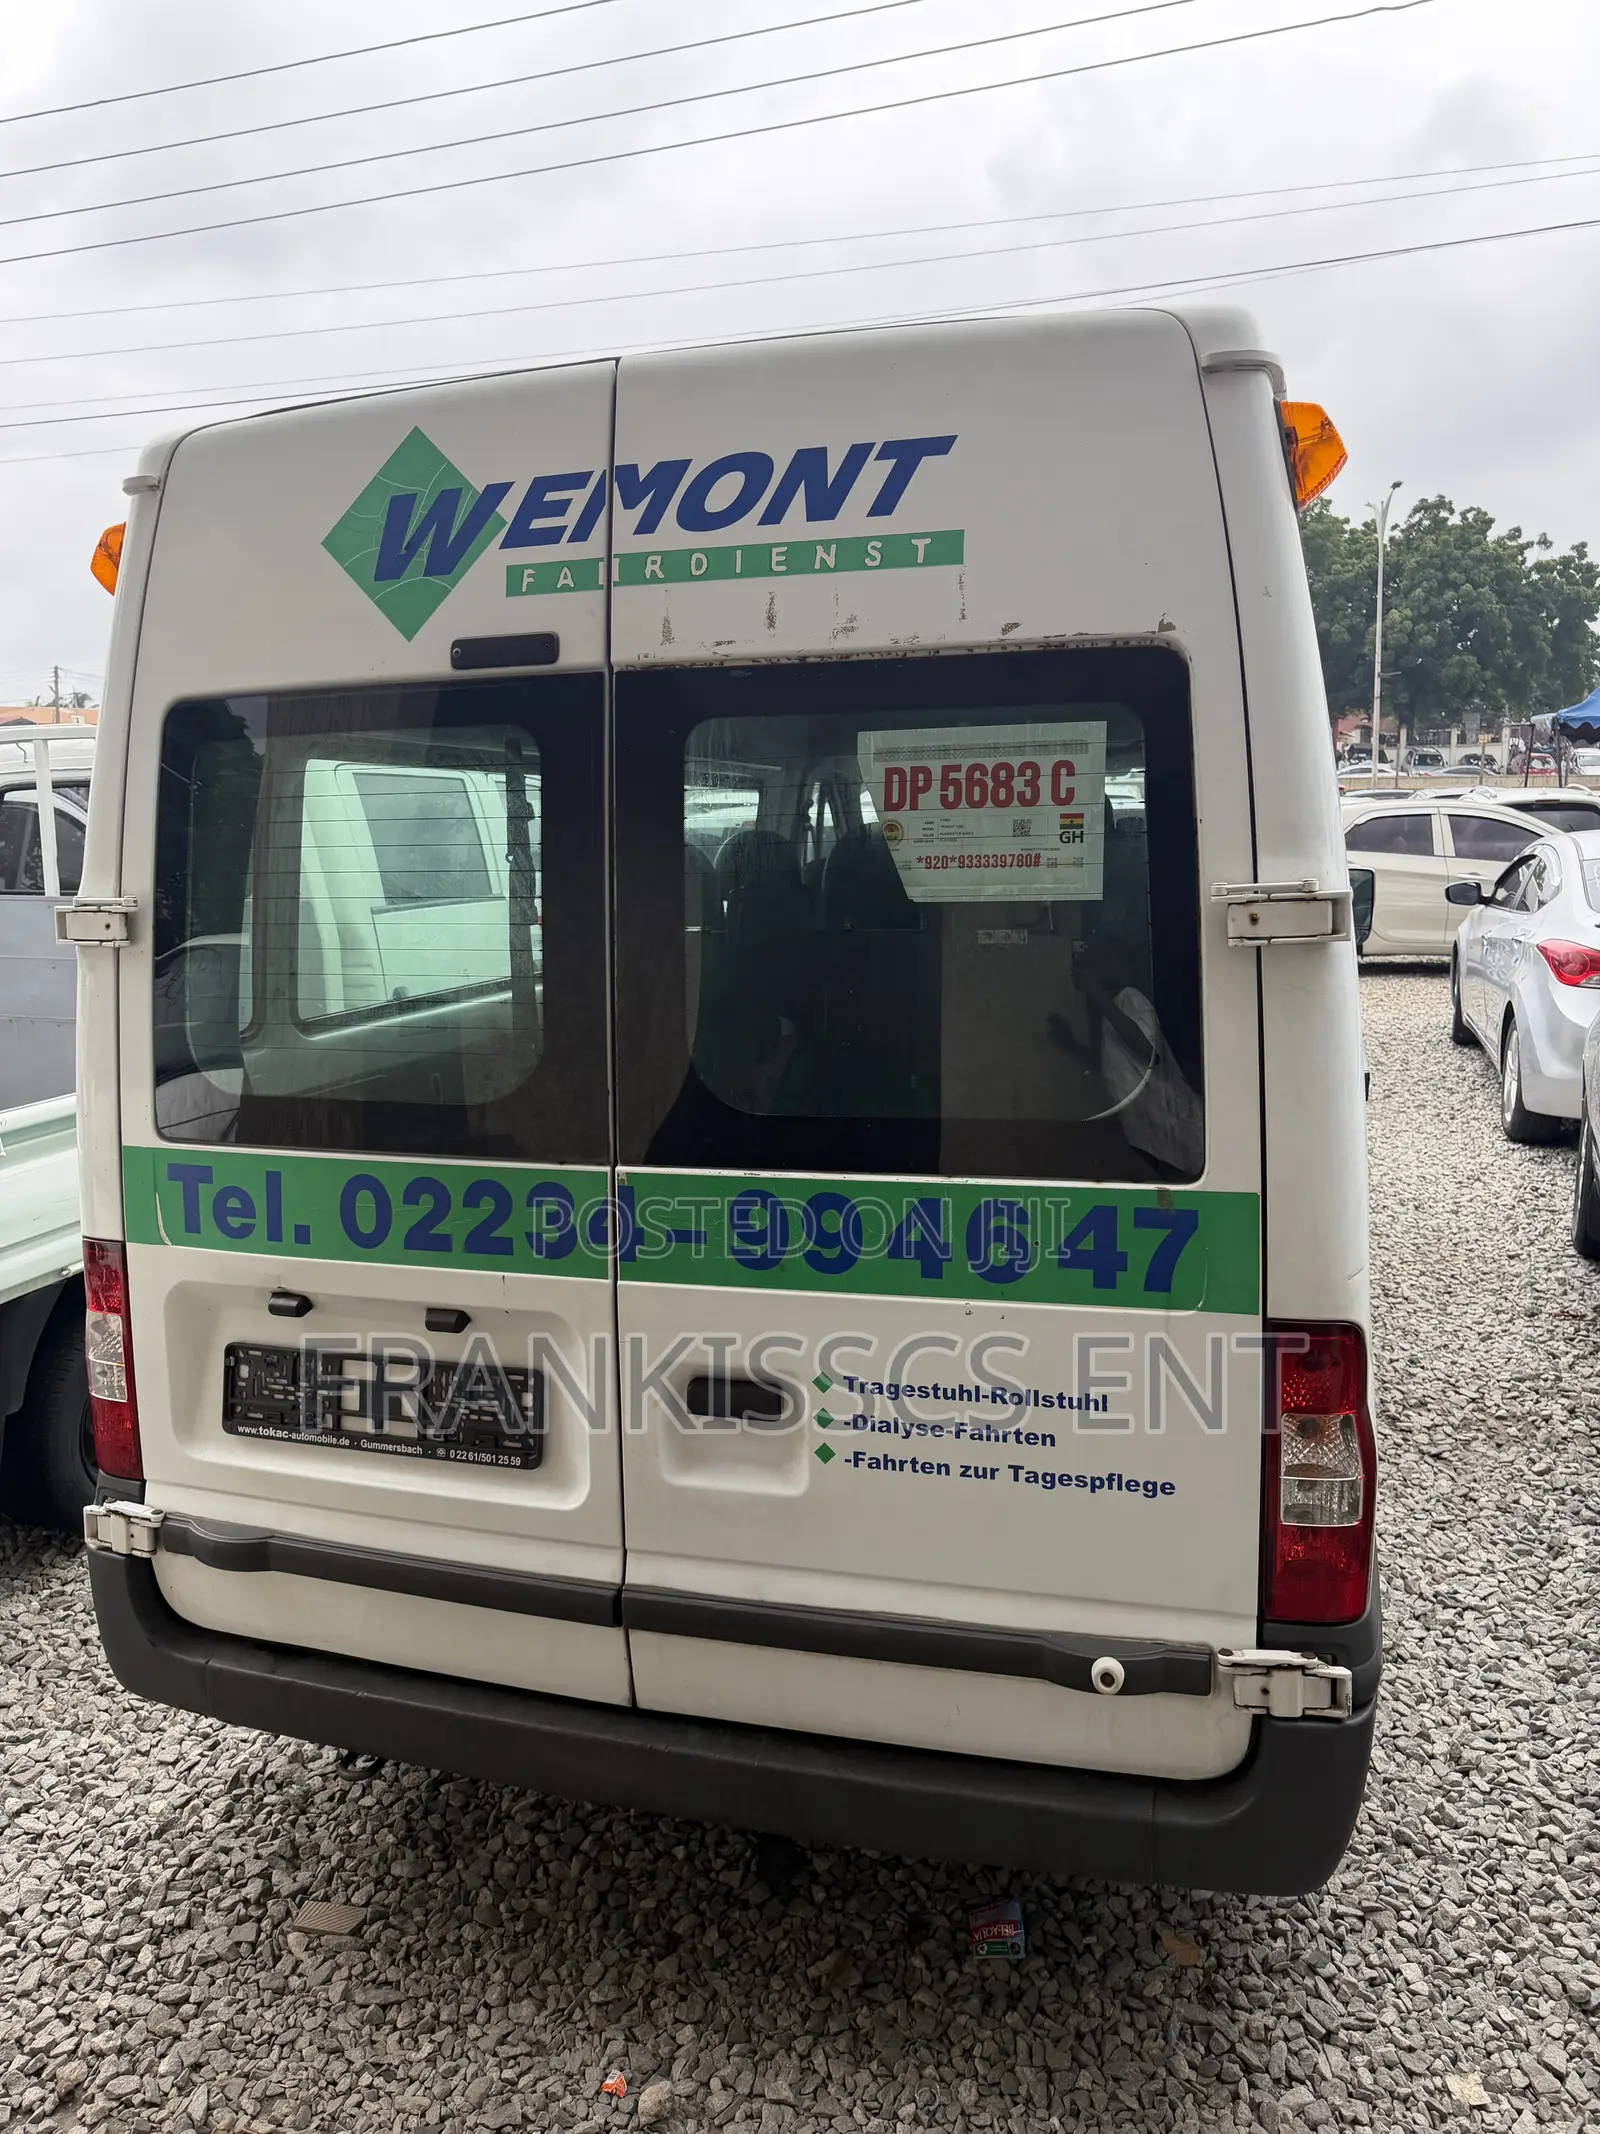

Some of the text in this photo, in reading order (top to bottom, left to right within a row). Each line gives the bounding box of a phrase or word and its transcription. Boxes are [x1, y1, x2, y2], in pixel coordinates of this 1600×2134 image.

[374, 435, 958, 581] WEMONT
[884, 760, 1075, 811] DP 5683 C
[1059, 831, 1084, 844] GH
[167, 1163, 1199, 1293] Tel. 02234-994647
[843, 1375, 1108, 1412] Tragestuhl-Rollstuhl
[237, 1425, 350, 1445] www.tokac-automobile.de
[360, 1439, 422, 1454] Gummersbach
[844, 1451, 1176, 1498] -Fahrten zur Tagespflege
